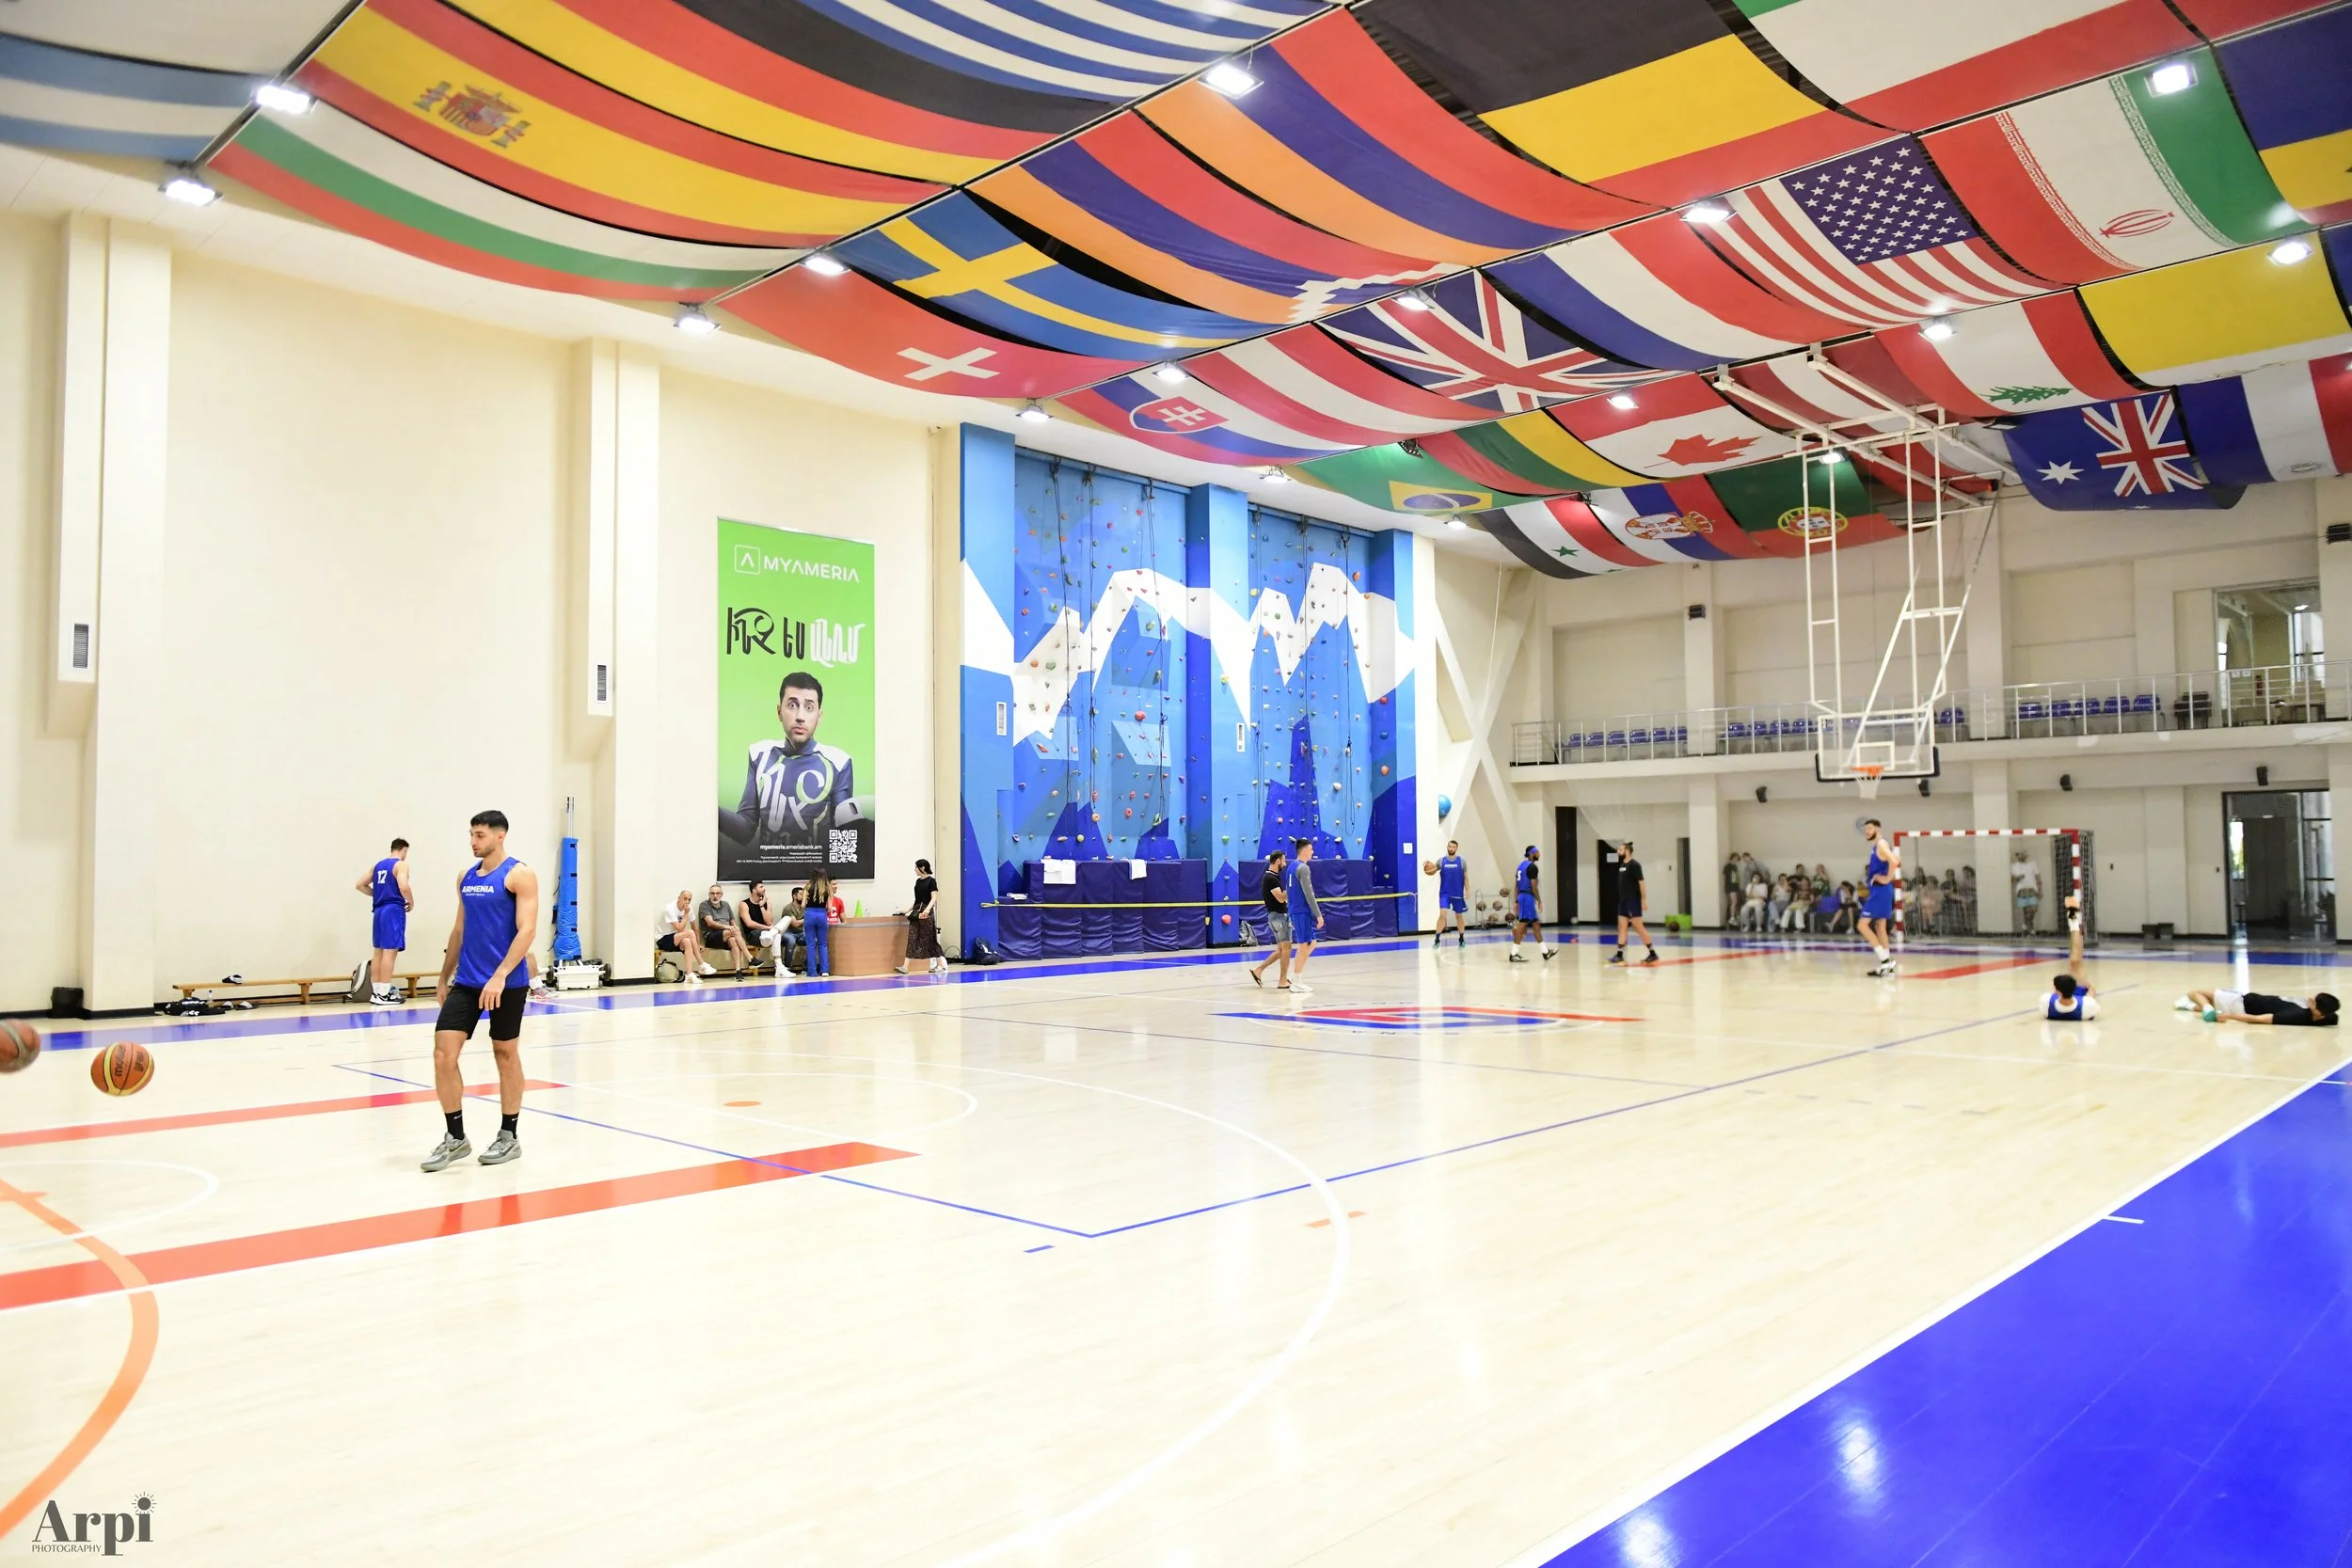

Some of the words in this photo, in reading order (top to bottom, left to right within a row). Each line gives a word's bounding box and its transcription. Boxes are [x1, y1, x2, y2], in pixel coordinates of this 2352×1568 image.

[763, 555, 860, 583] MYAMERIA
[377, 869, 388, 884] 17
[461, 885, 495, 894] ARMENIA
